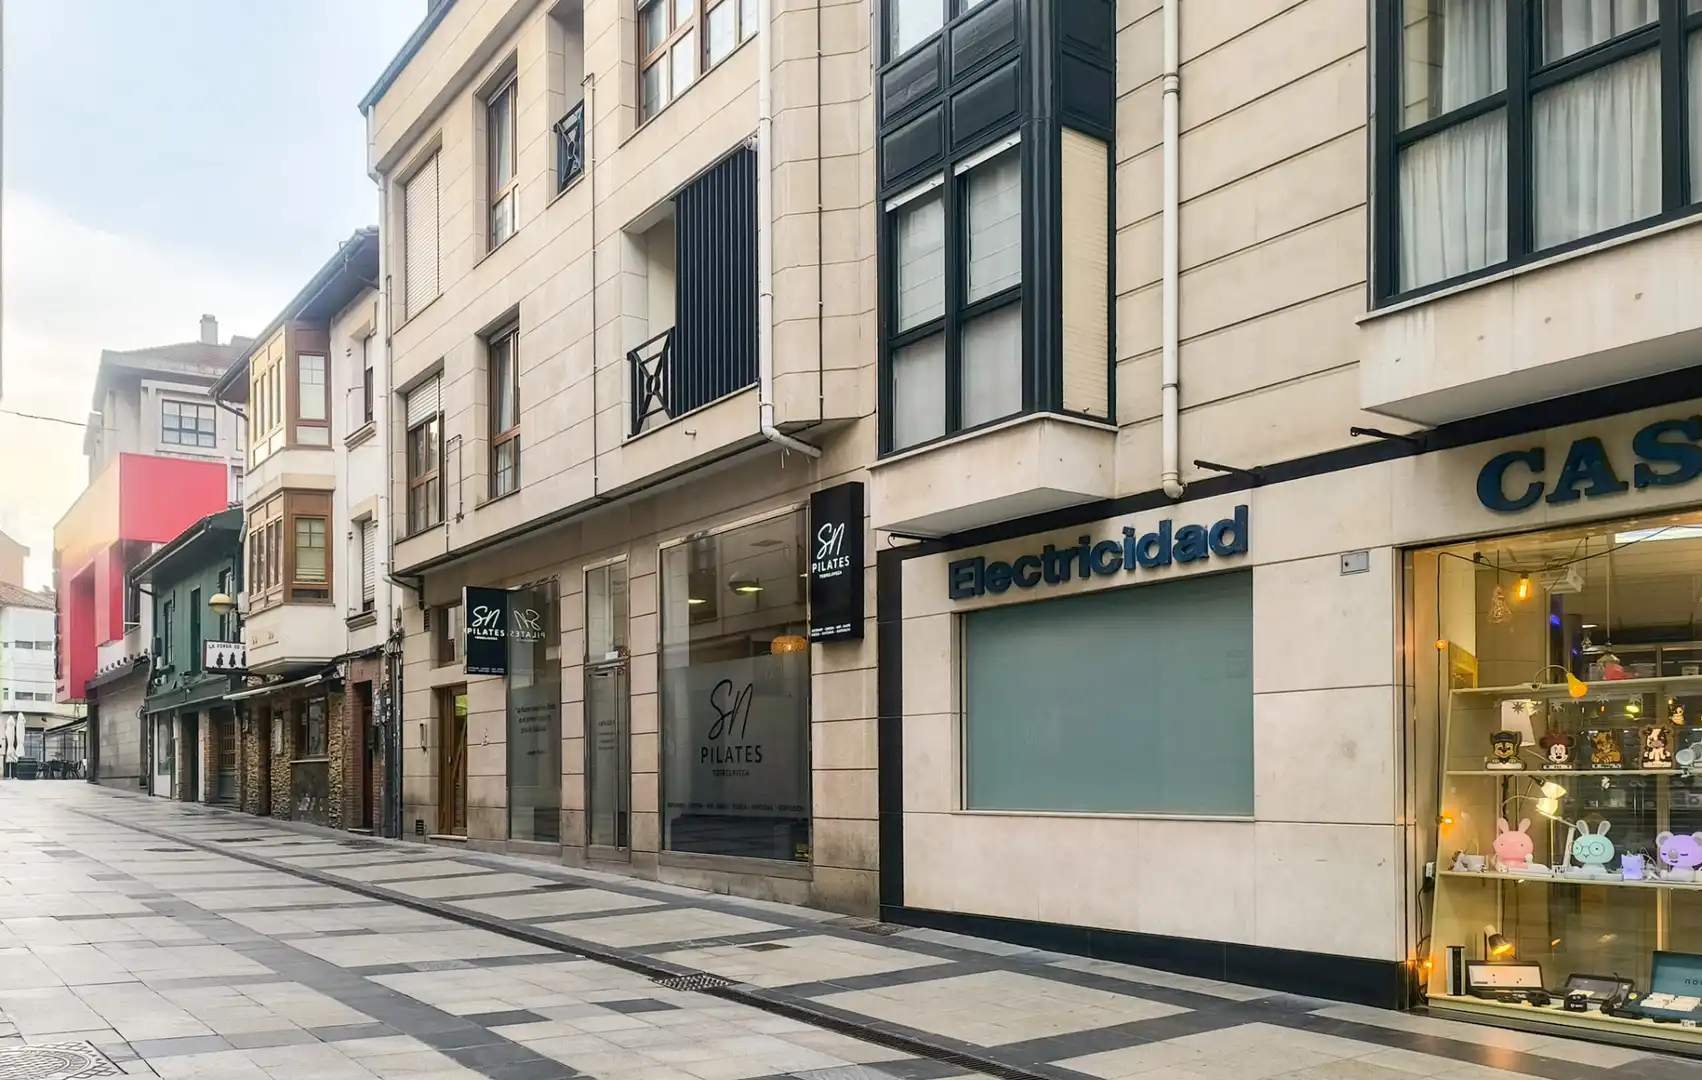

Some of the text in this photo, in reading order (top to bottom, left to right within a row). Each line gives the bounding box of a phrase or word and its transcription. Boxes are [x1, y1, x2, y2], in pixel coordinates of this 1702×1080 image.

[1477, 415, 1702, 512] CAS
[949, 504, 1249, 600] Electricidad
[812, 555, 850, 574] PILATES
[467, 627, 505, 637] PILATES
[700, 745, 763, 764] PILATES
